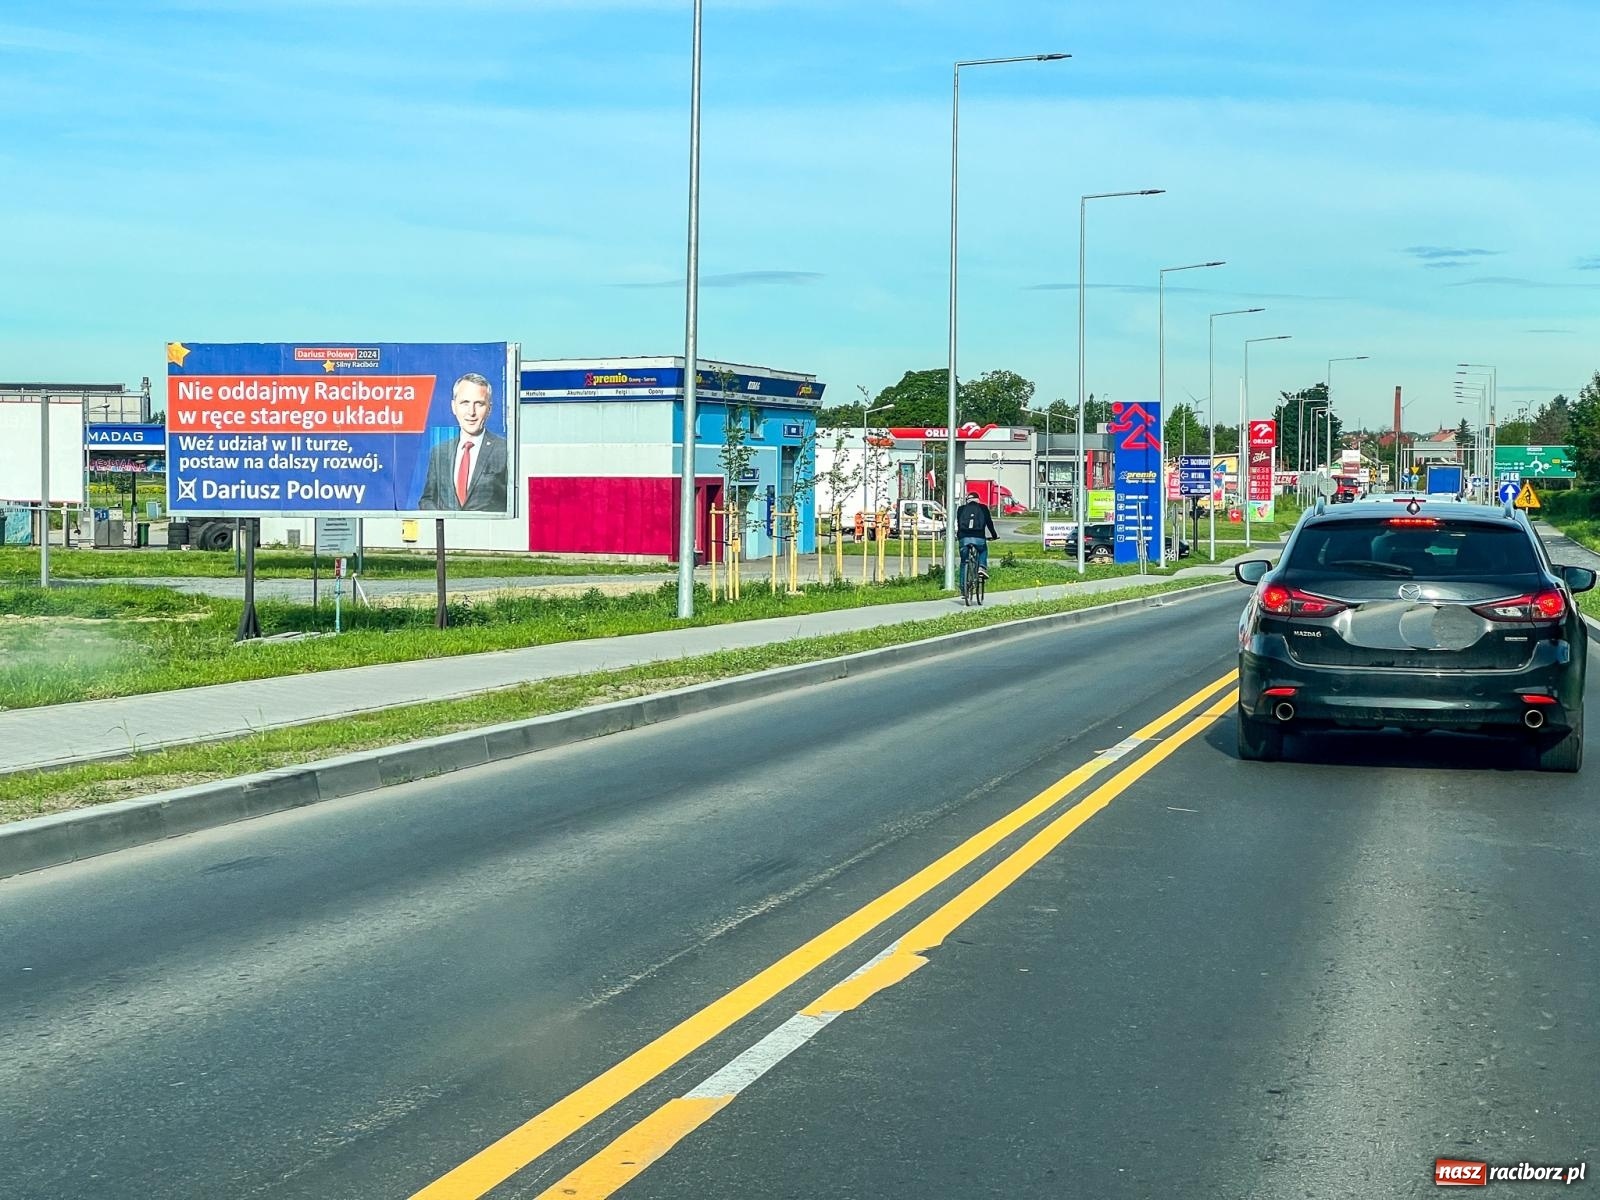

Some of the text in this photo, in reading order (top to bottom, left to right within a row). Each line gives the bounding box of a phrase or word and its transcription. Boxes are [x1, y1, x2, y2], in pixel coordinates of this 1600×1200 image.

[298, 350, 377, 359] Dariusz Polowy 2024
[592, 372, 628, 386] premio
[178, 381, 415, 405] Nie oddajmy Raciborza
[178, 406, 404, 430] w ręce starego układu
[179, 436, 214, 451] Weź
[218, 435, 267, 451] udział
[271, 440, 288, 451] w
[305, 437, 353, 454] turze,
[179, 453, 384, 473] postaw na dalszy rozwój.
[1126, 471, 1157, 479] premio
[202, 479, 366, 503] Dariusz Polowy
